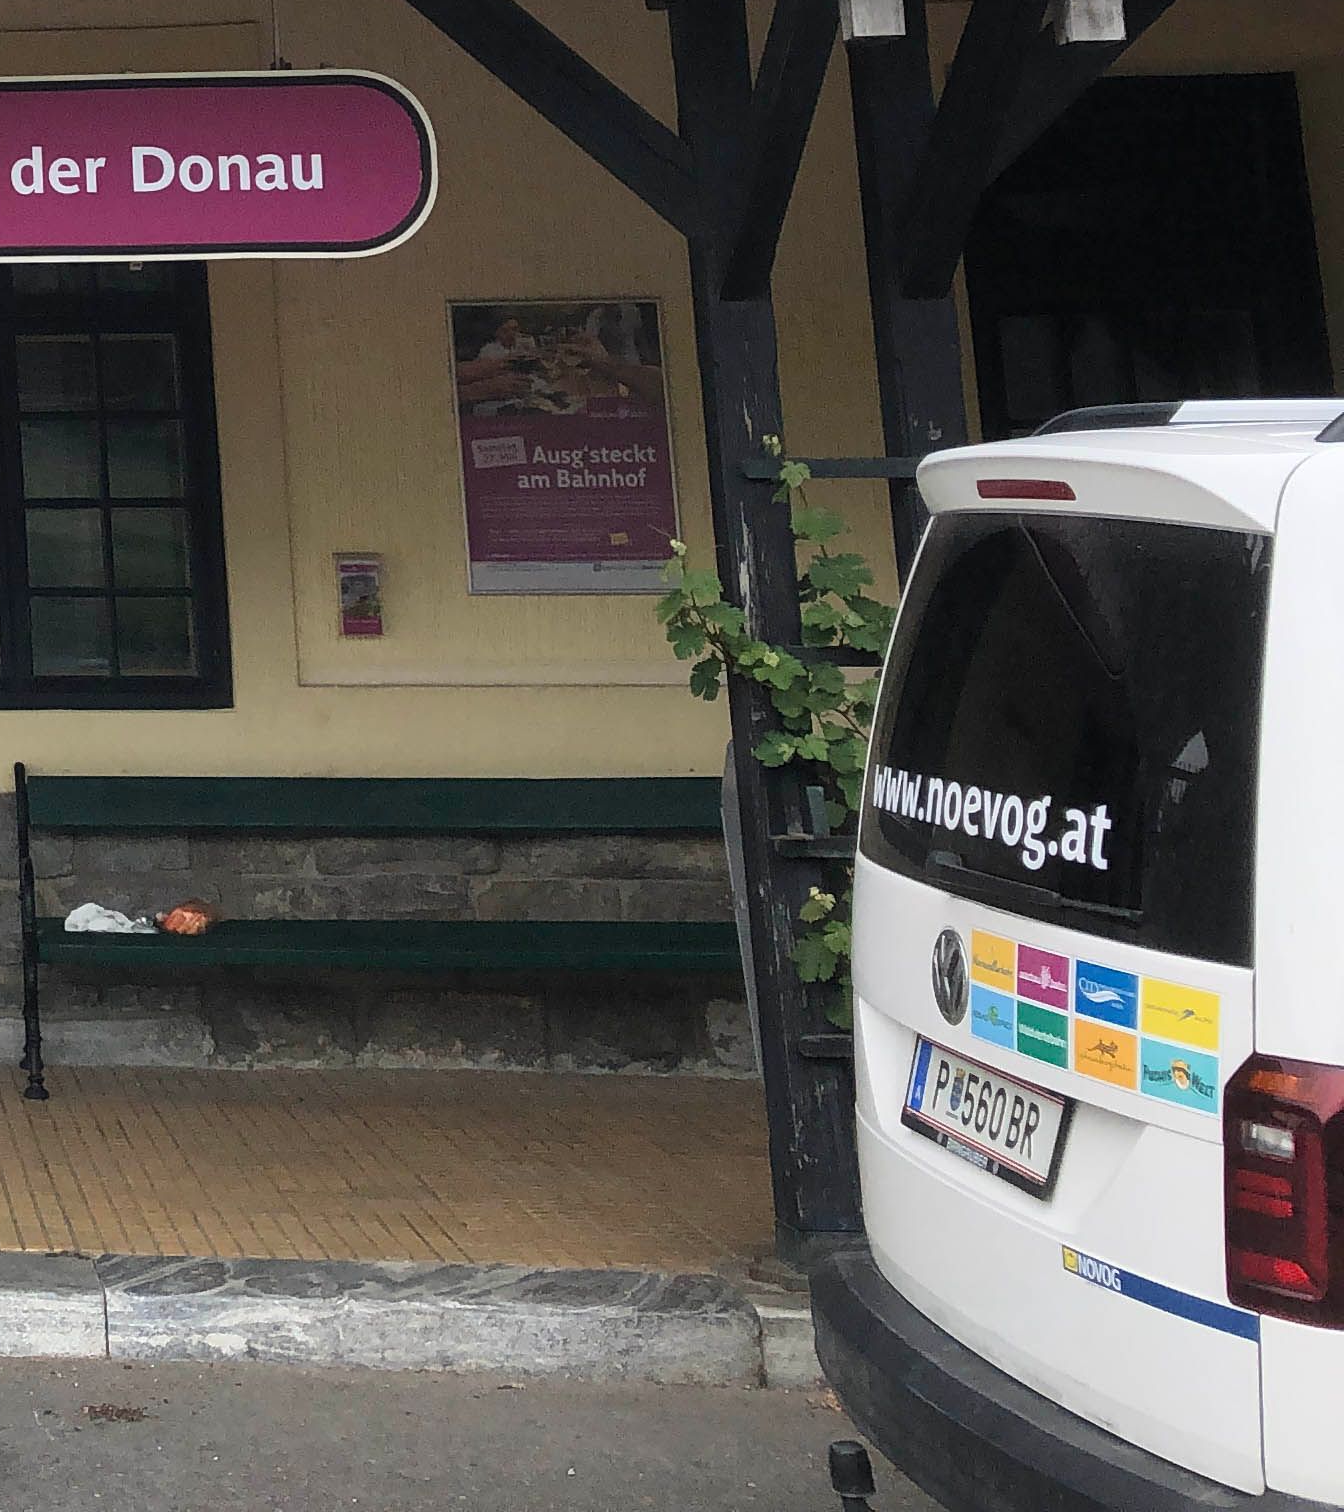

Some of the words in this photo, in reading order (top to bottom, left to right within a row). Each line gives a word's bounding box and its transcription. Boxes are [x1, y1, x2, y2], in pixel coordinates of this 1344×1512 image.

[11, 145, 107, 196] der
[131, 144, 325, 194] Donau
[517, 472, 550, 488] am
[556, 467, 647, 488] Bahnhof
[873, 764, 1112, 871] www.noevog.at
[932, 1059, 950, 1111] P
[961, 1072, 1007, 1141] 560
[1005, 1094, 1040, 1160] BR
